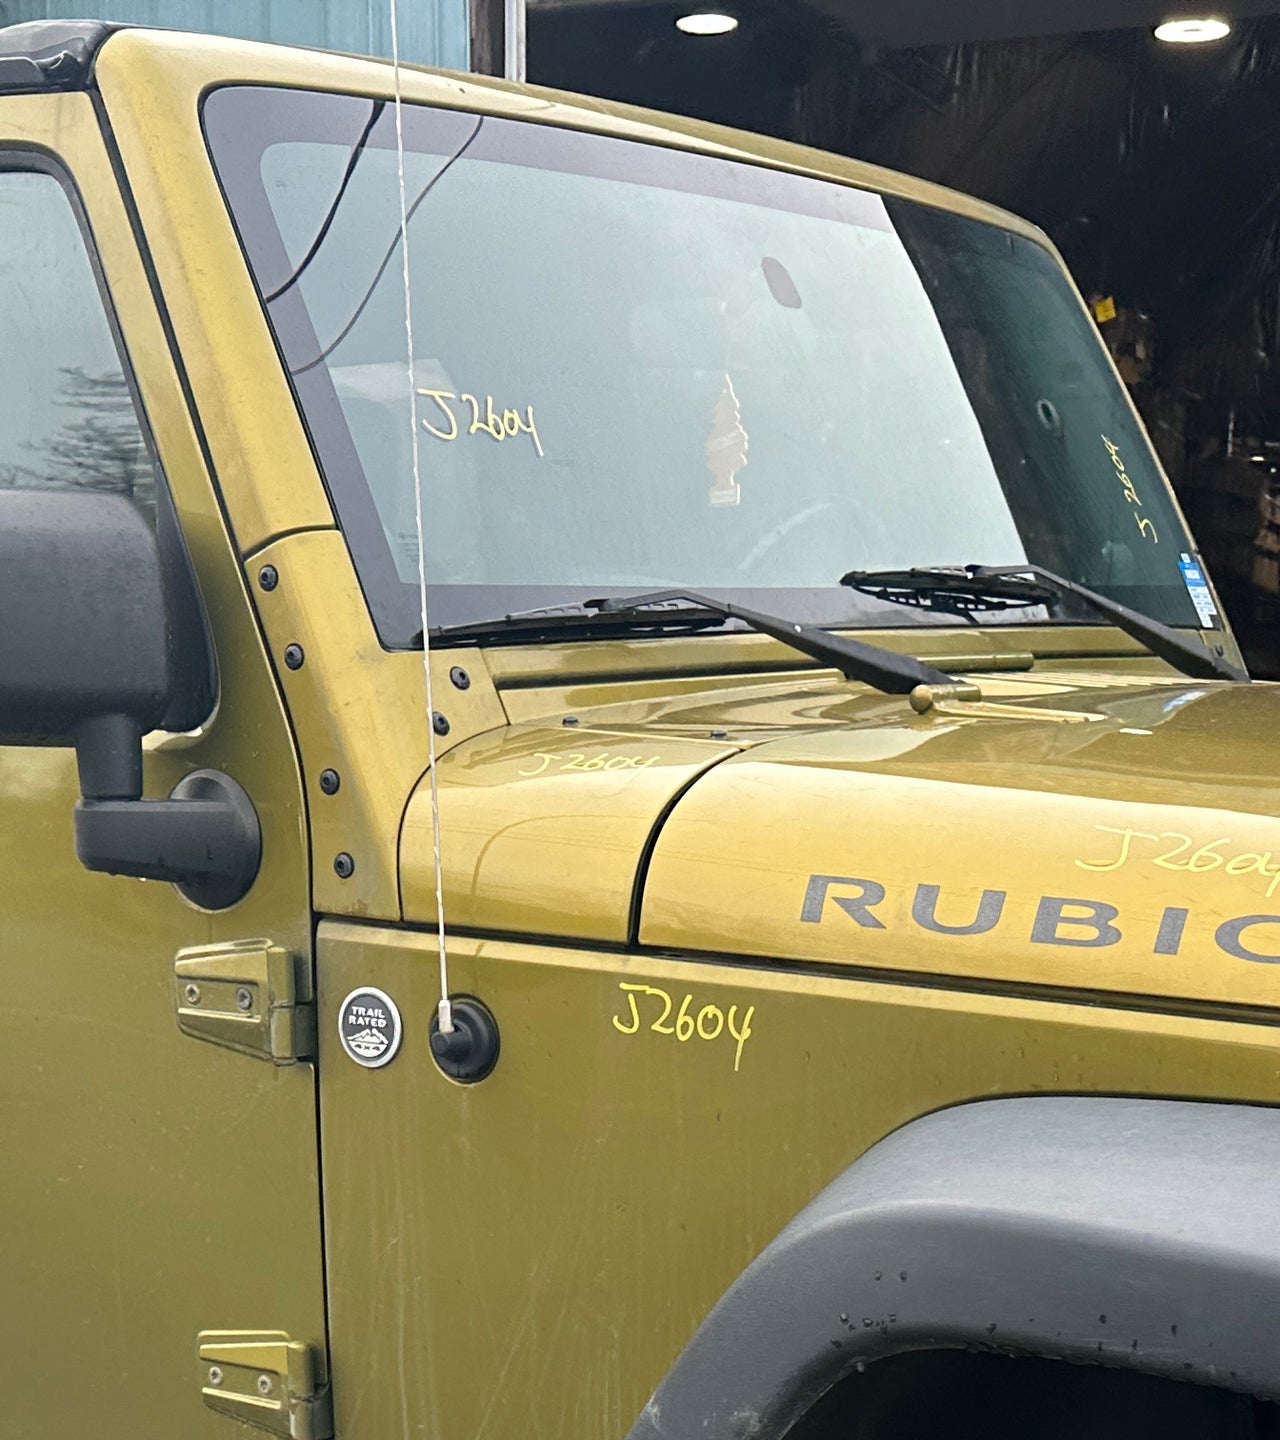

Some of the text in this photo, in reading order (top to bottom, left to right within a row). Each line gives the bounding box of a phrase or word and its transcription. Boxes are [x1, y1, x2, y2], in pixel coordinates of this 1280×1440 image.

[417, 388, 544, 457] J2604
[518, 752, 661, 781] J2604
[348, 1015, 387, 1028] RATED
[351, 1006, 386, 1018] TRAIL
[612, 981, 755, 1072] J2604
